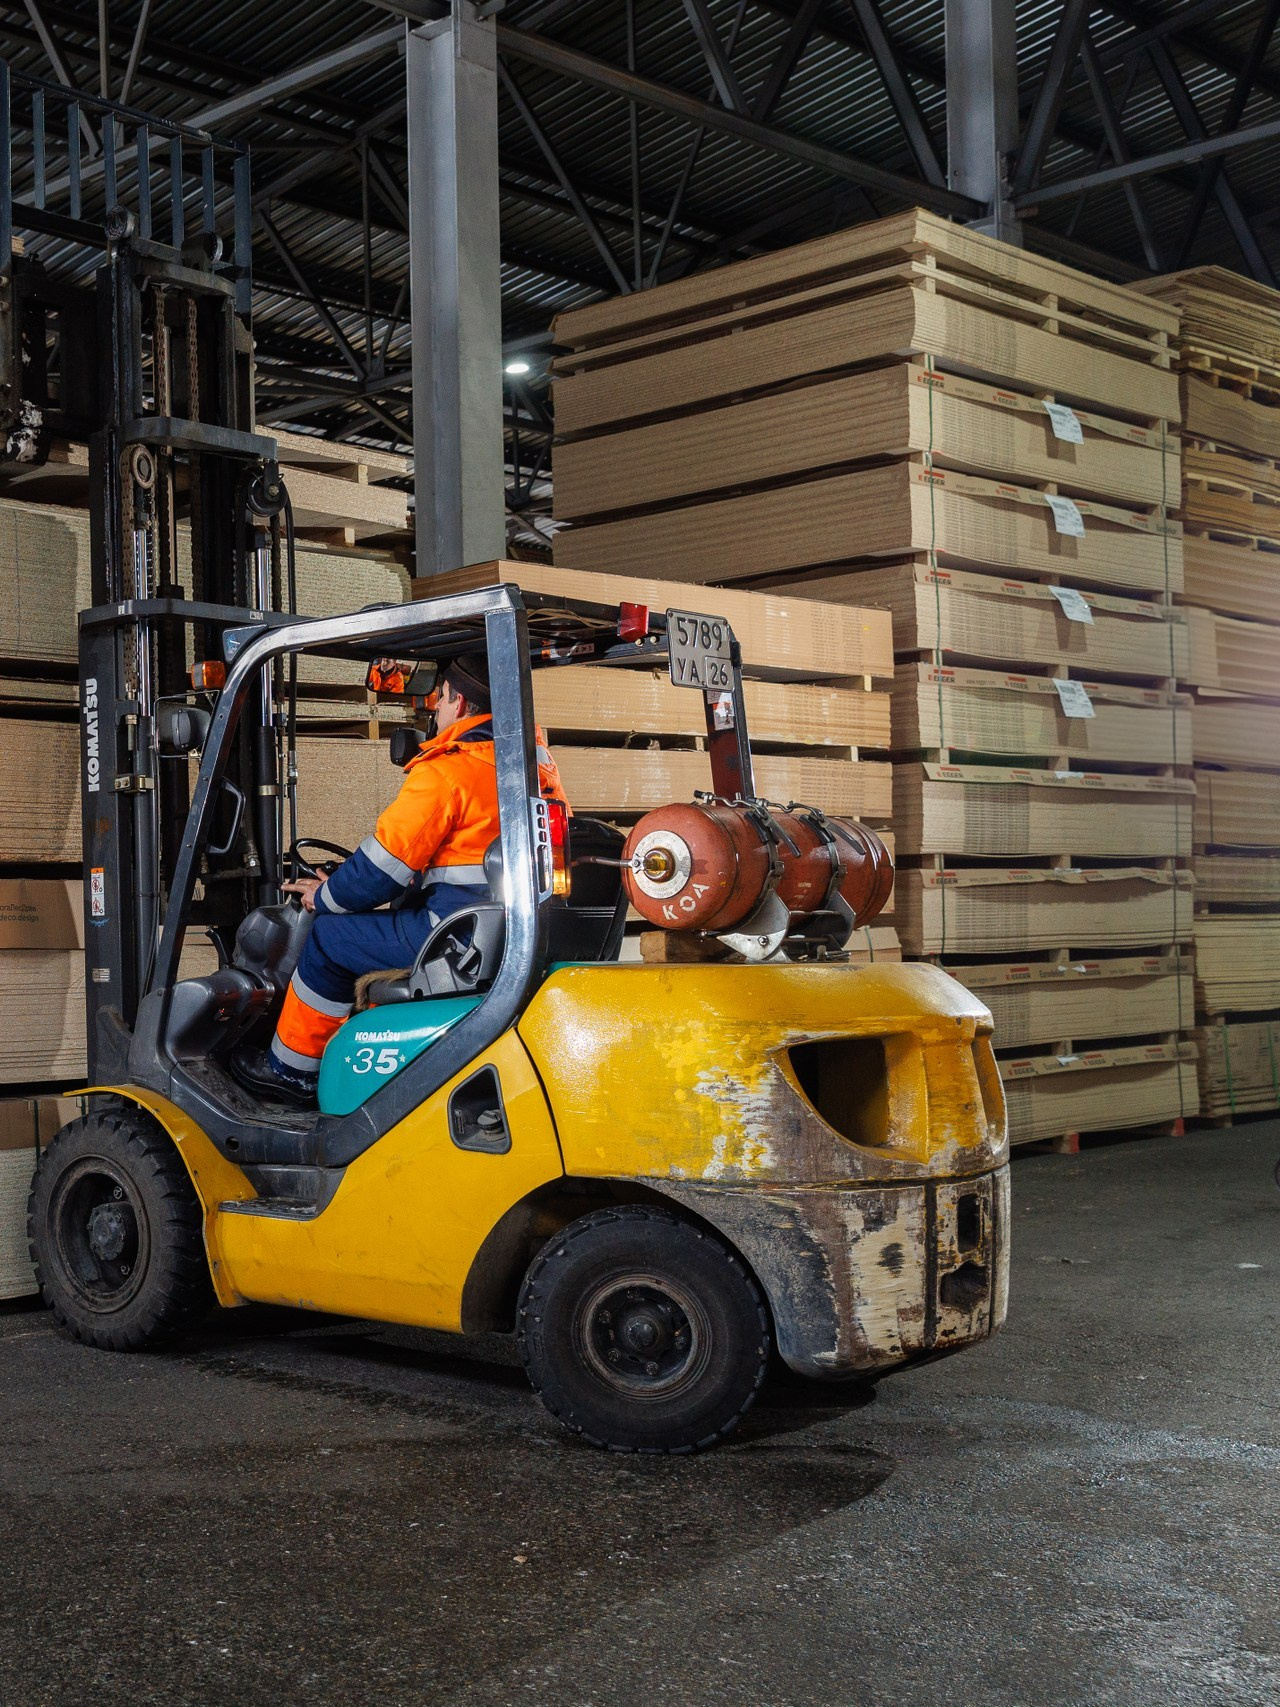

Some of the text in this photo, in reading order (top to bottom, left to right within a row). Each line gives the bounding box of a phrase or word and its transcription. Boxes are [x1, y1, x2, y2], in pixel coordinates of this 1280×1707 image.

[676, 616, 723, 652] 5789
[709, 661, 729, 687] 26
[84, 677, 100, 793] KOMATSU
[354, 1029, 401, 1042] KOMATSU
[352, 1047, 400, 1075] 35
